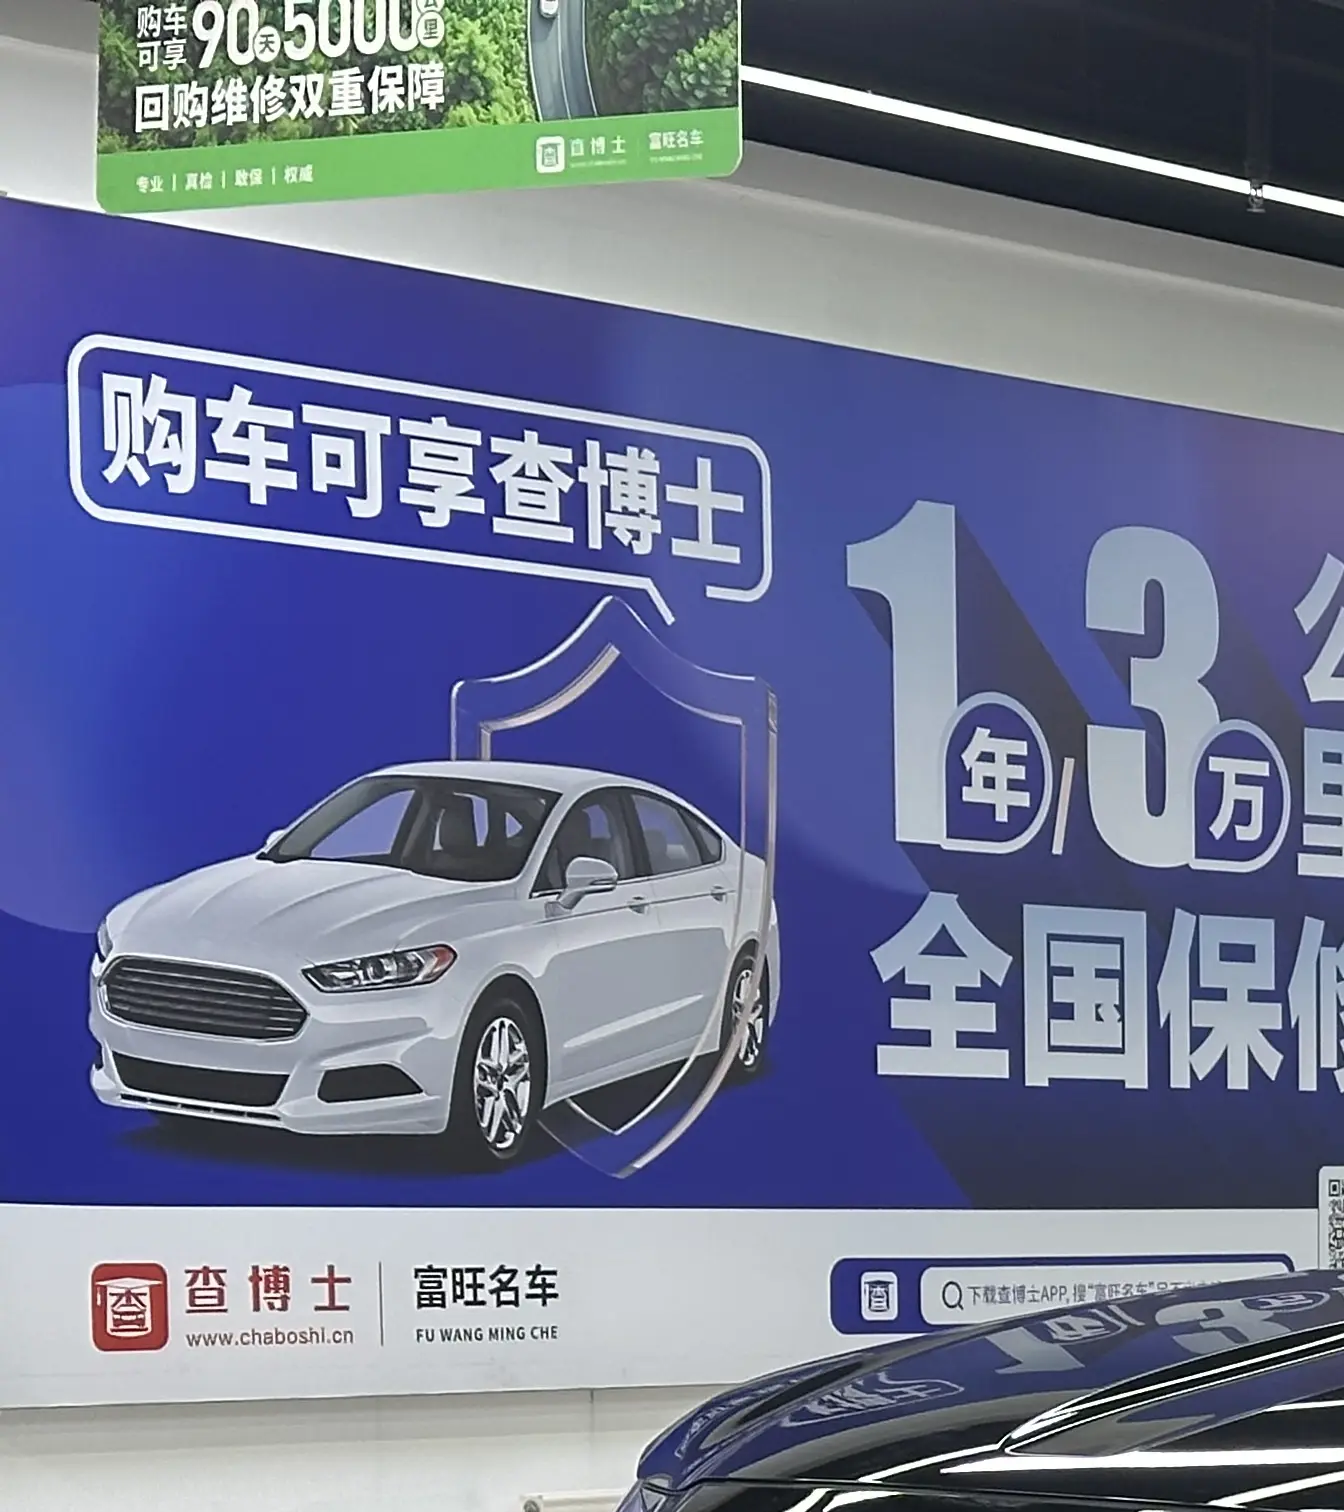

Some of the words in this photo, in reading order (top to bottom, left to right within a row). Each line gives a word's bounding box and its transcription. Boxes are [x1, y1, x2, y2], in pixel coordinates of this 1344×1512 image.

[137, 4, 188, 38] 购车
[137, 38, 188, 72] 可享
[135, 63, 446, 133] 回购维修双重保障
[101, 372, 745, 565] 购车可享查博士
[184, 1264, 352, 1314] 查博士
[413, 1263, 560, 1311] 富旺名车
[416, 1329, 435, 1344] FU
[440, 1327, 484, 1343] WANG
[488, 1326, 525, 1342] MING
[530, 1325, 558, 1341] CHE
